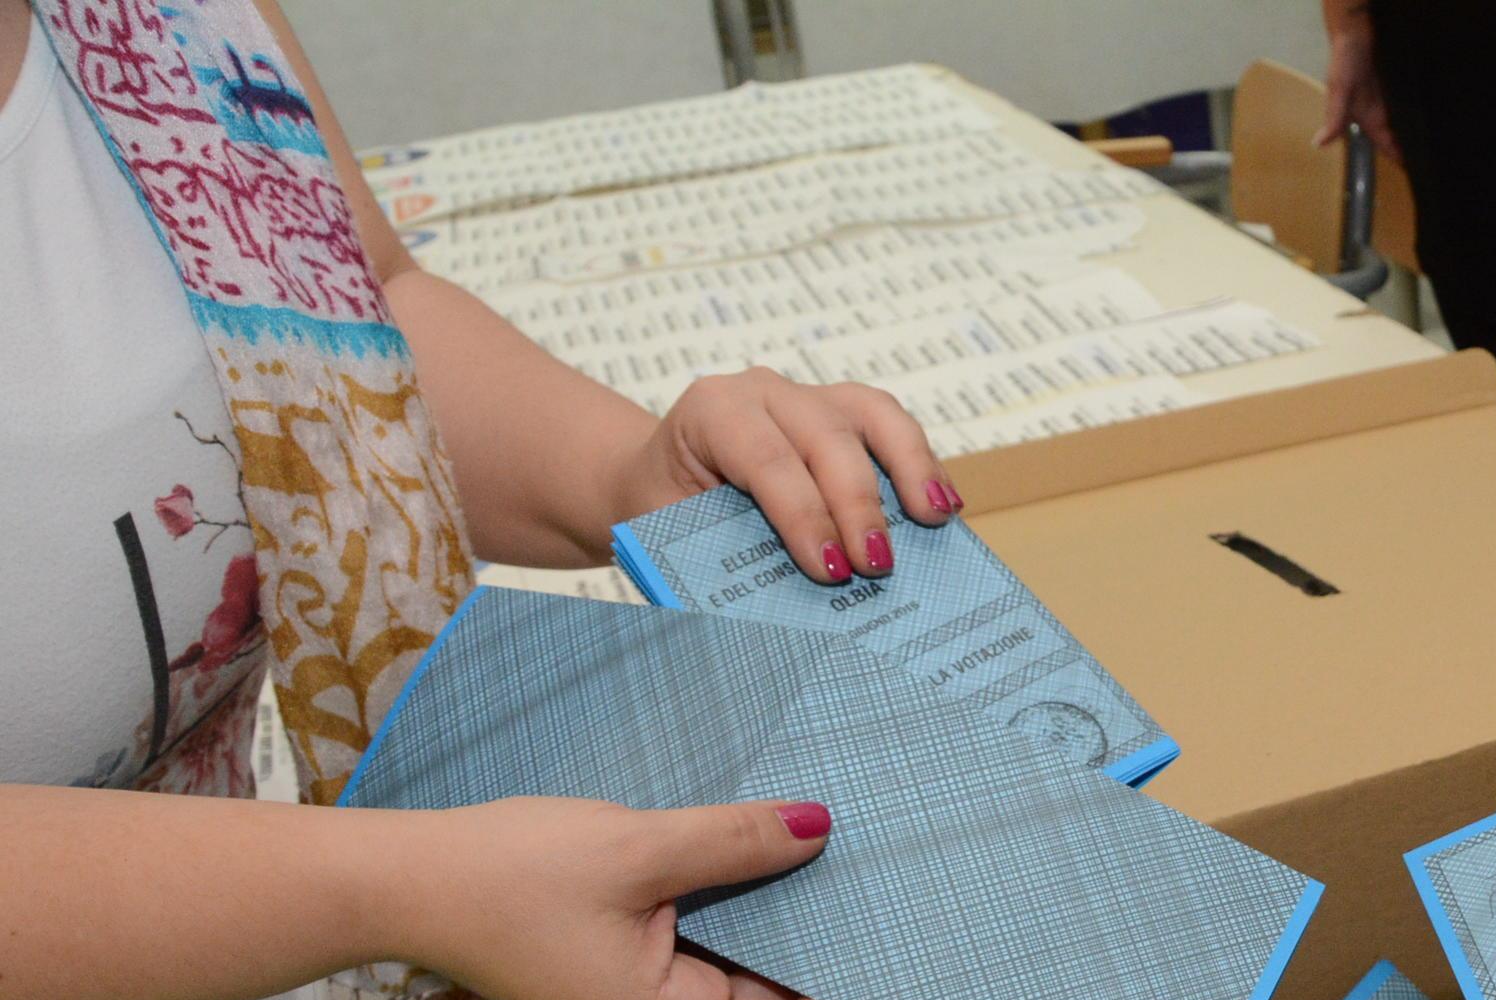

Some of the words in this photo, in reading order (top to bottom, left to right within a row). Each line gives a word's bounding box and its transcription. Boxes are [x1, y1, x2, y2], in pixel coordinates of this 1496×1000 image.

[721, 535, 782, 574] ELEZION
[709, 591, 722, 609] E
[722, 578, 752, 603] DEL
[829, 578, 886, 614] OLBIA
[848, 612, 891, 640] GIUGNO
[892, 599, 920, 620] 2016
[928, 665, 952, 688] LA
[951, 625, 1033, 676] VOTAZIONE
